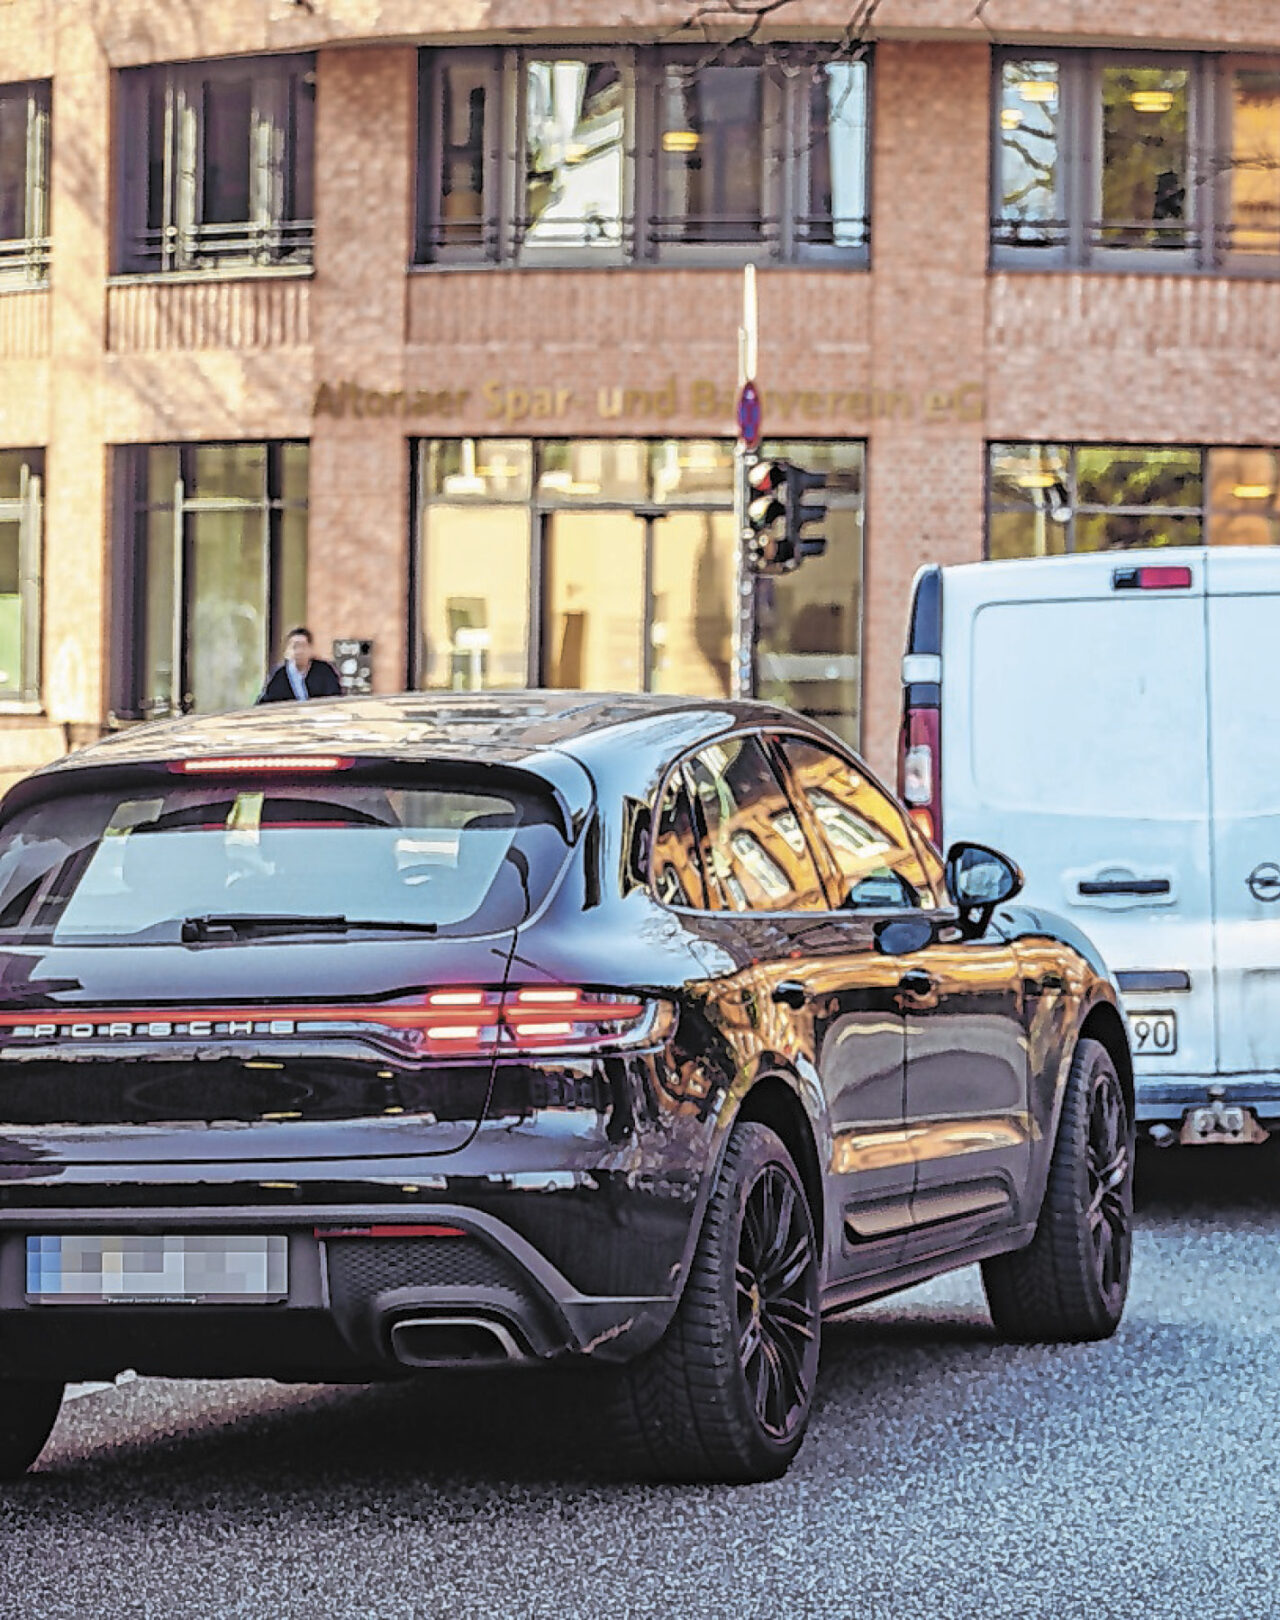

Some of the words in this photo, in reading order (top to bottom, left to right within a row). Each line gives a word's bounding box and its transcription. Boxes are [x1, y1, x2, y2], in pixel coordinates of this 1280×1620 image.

[597, 376, 677, 418] und
[34, 1020, 295, 1038] PORSCHE
[1134, 1020, 1170, 1049] 90
